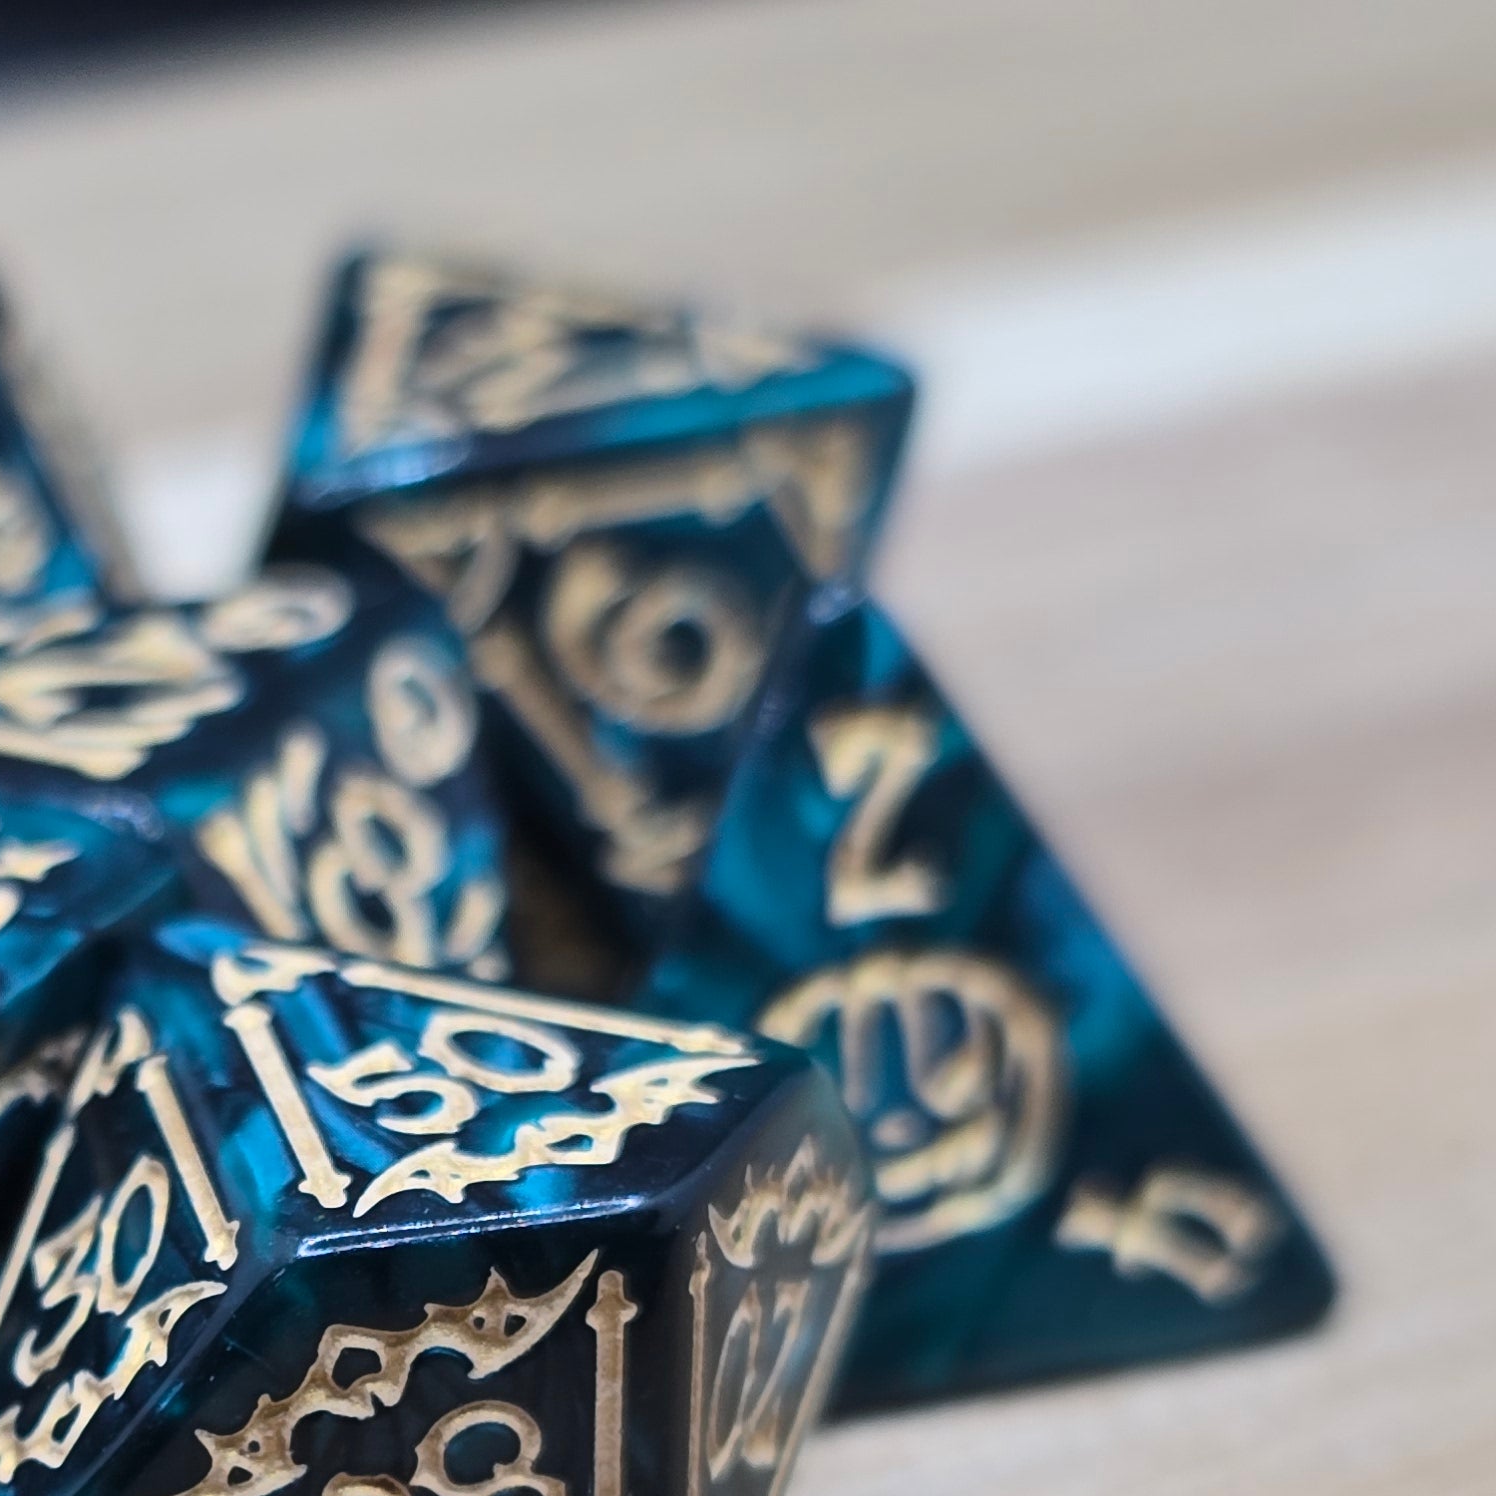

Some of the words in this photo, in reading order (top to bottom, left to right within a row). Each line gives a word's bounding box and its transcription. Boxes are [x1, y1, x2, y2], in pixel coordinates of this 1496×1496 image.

[810, 708, 938, 926] 2
[308, 1012, 579, 1135] 50
[12, 1154, 170, 1387] 30
